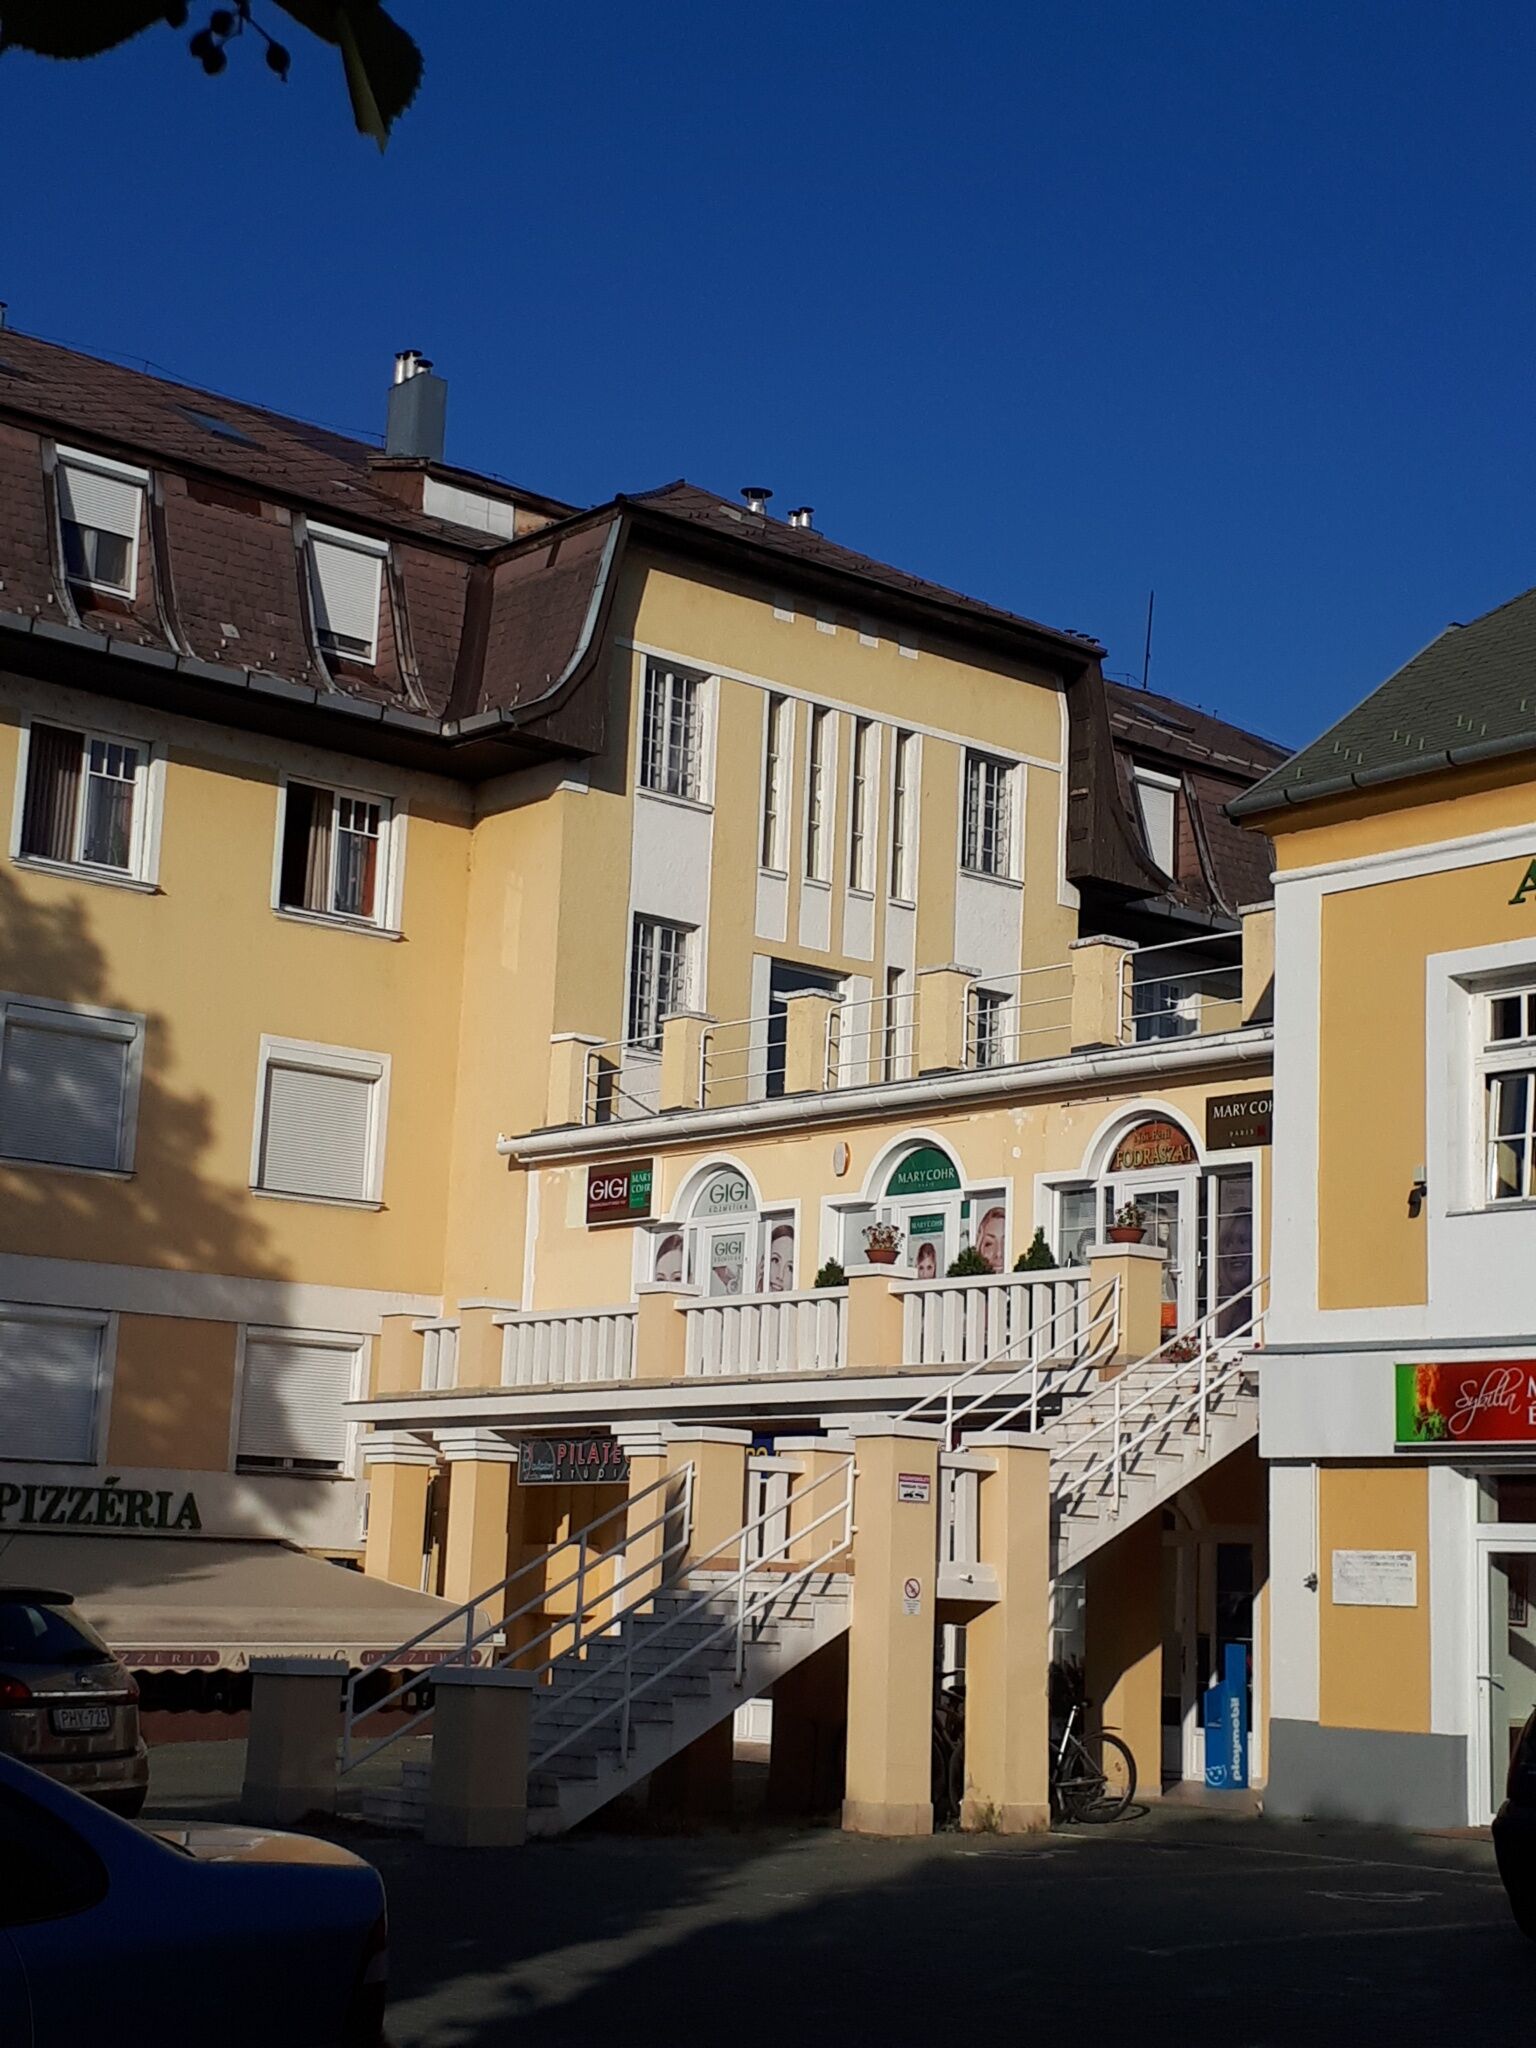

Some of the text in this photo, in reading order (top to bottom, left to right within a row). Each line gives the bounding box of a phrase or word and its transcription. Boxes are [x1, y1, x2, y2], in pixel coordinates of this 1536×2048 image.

[1213, 1102, 1248, 1119] MARY
[590, 1177, 628, 1201] GIGI
[709, 1181, 749, 1204] GIGI
[714, 1240, 742, 1257] GIGI
[0, 1476, 203, 1530] PIZZÉRIA
[1230, 1698, 1242, 1781] playmobil
